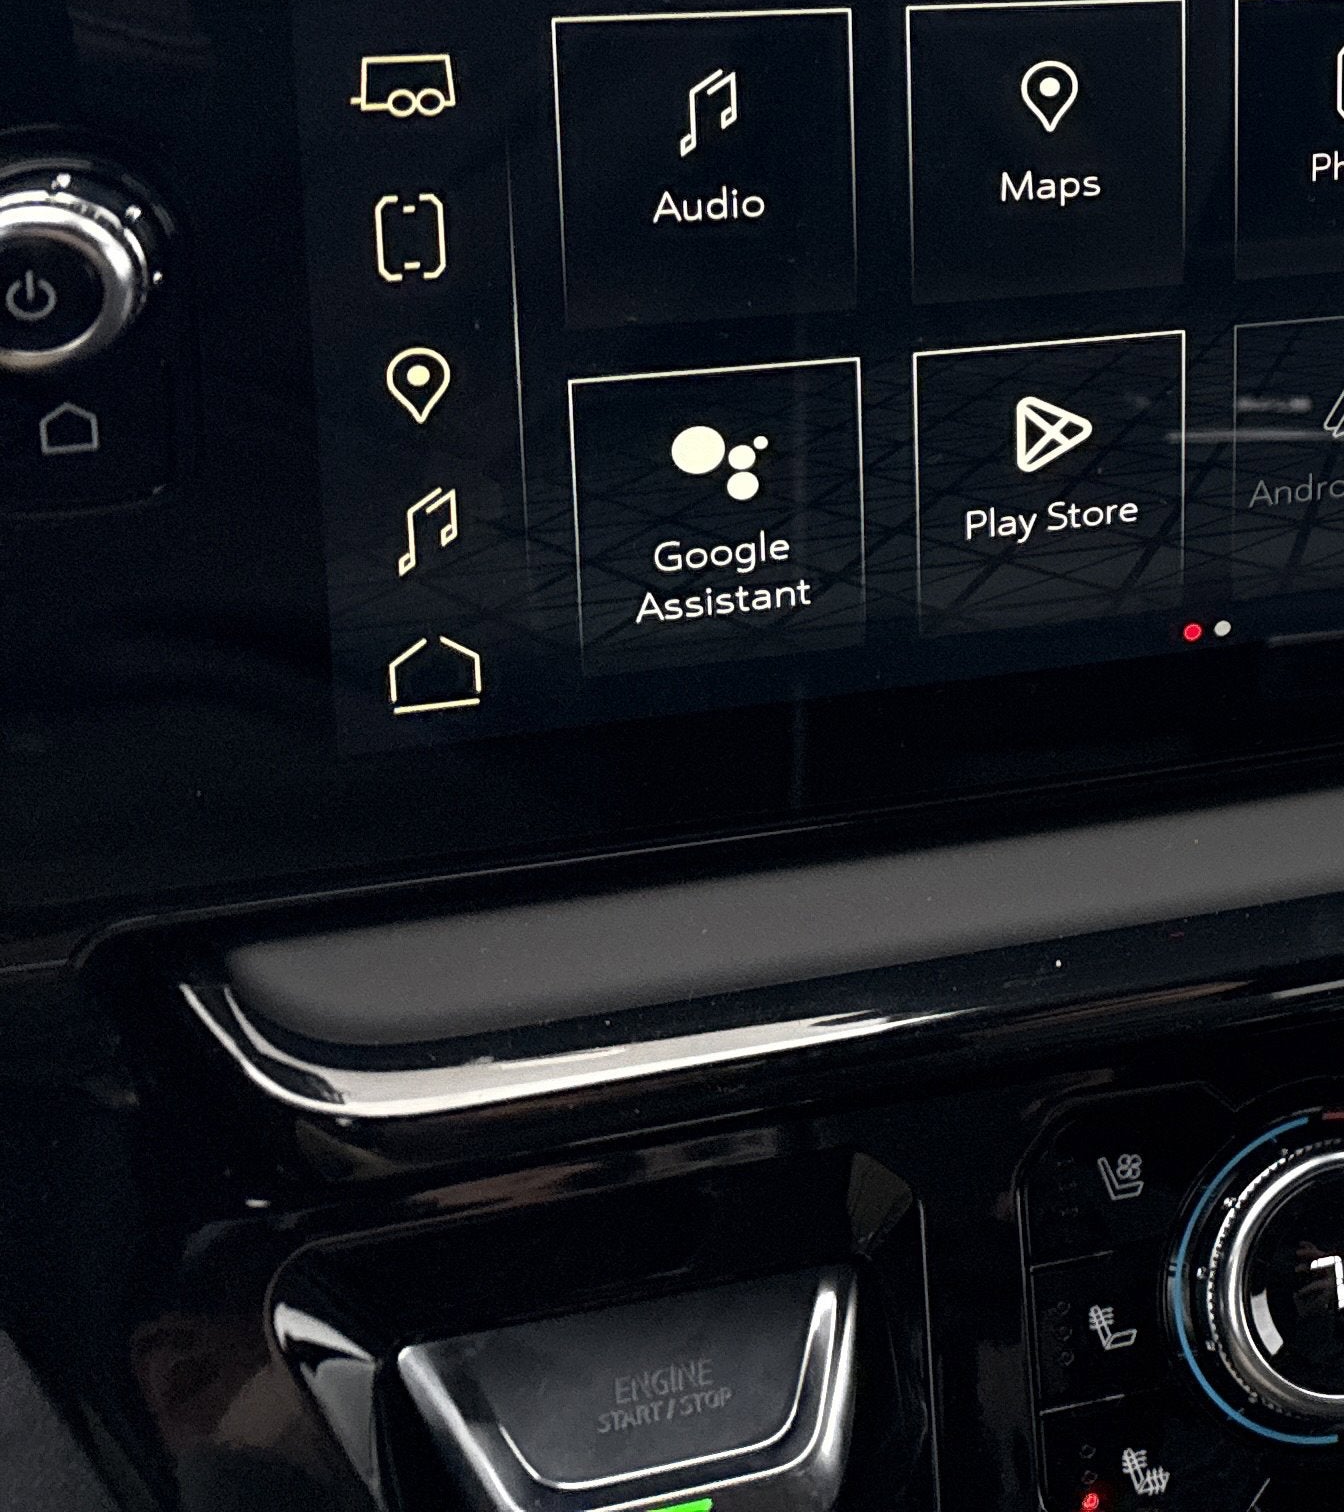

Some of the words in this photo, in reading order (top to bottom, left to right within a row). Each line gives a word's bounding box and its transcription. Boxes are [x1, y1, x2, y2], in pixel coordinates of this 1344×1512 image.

[652, 184, 766, 224] Audio
[1000, 170, 1102, 207] Maps
[965, 506, 1037, 545] Play
[1047, 498, 1140, 533] Store
[653, 530, 791, 575] Google
[635, 580, 812, 624] Assistant
[614, 1356, 714, 1405] ENGINE
[597, 1386, 734, 1434] START/STOP
